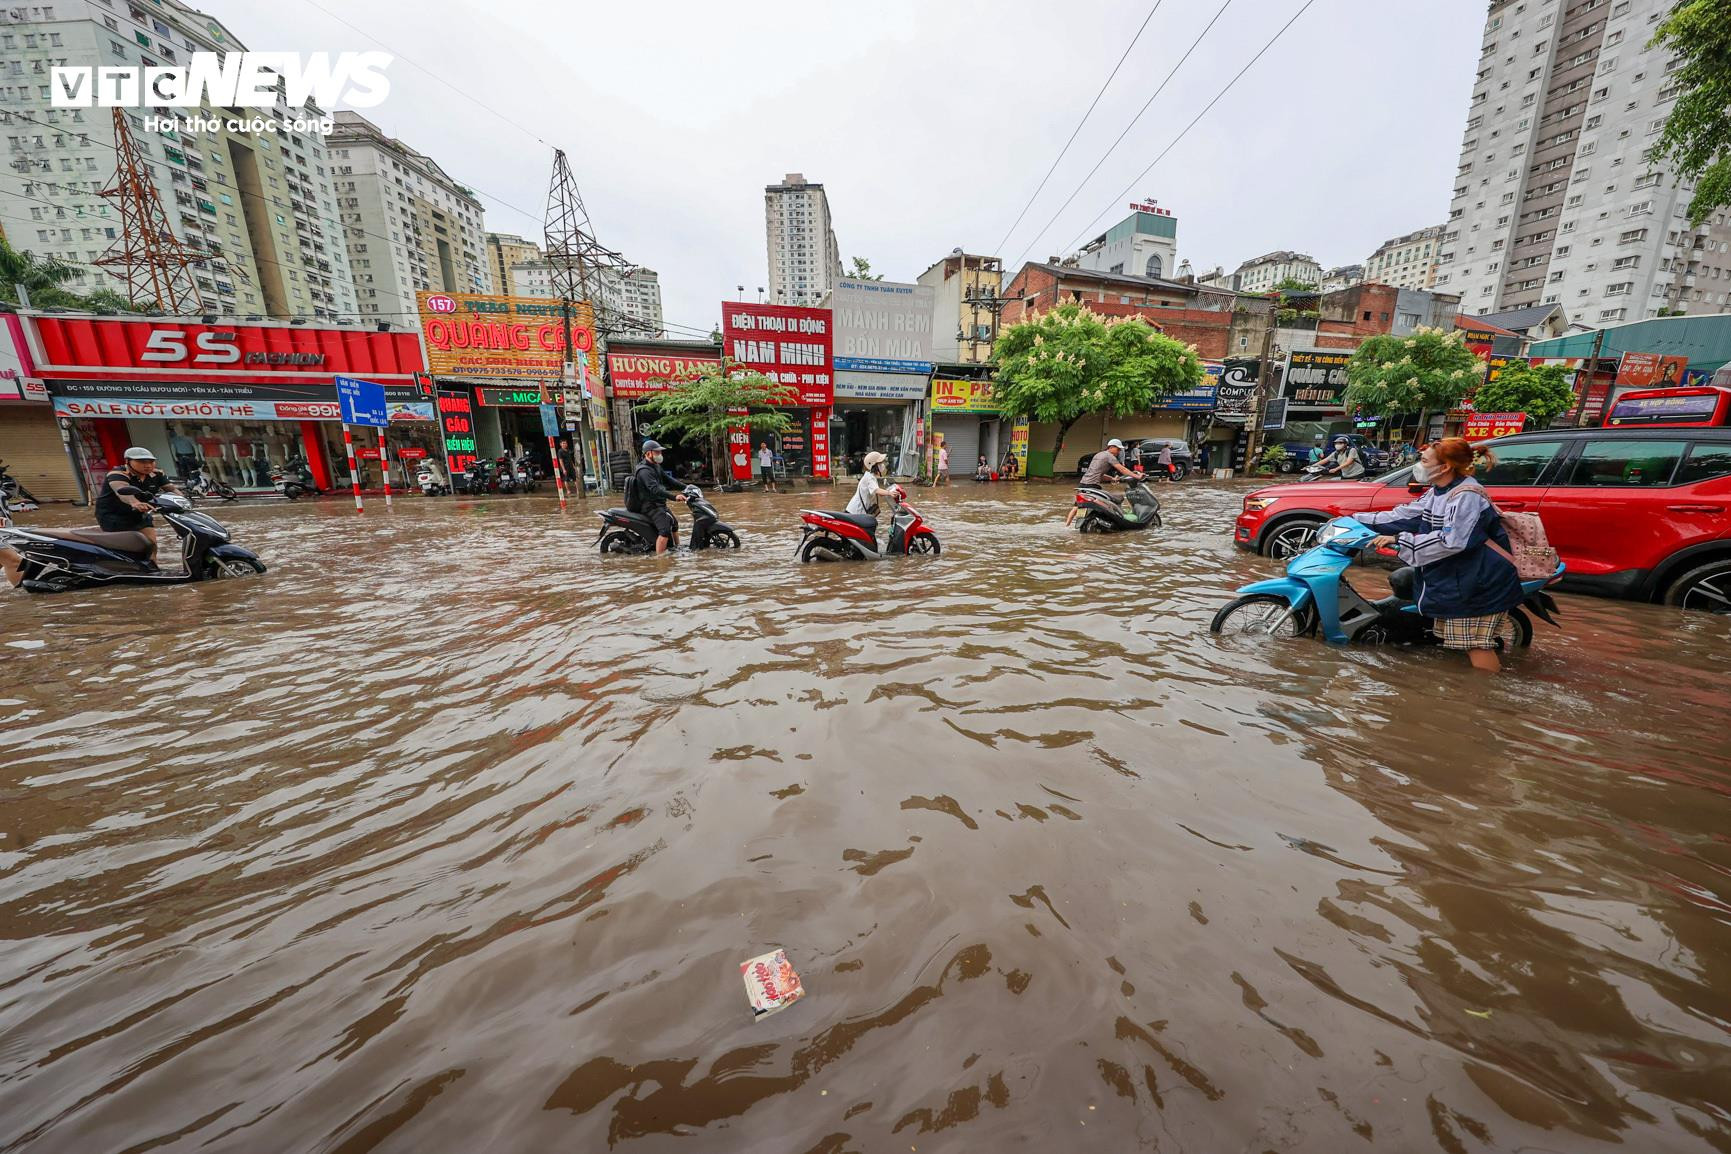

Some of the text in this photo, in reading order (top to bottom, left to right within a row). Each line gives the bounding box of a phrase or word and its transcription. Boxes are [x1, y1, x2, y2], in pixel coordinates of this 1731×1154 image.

[429, 299, 452, 311] 157
[426, 312, 593, 351] QUẢNG CÁO
[731, 312, 826, 335] ĐIỆN THOẠI DI ĐỘNG
[141, 329, 326, 366] 5S FASHION
[733, 340, 825, 366] NAM MINH
[611, 356, 671, 374] HƯƠNG
[1288, 364, 1327, 385] QUẢNG
[26, 382, 45, 392] 5S
[936, 381, 954, 395] IN
[439, 392, 470, 413] QUẢNG
[513, 393, 542, 405] MICA
[67, 401, 255, 416] SALE NỐT CHỐT HÈ
[446, 416, 469, 433] CÁO
[1466, 427, 1518, 437] XE GA
[730, 431, 749, 446] KIỆN
